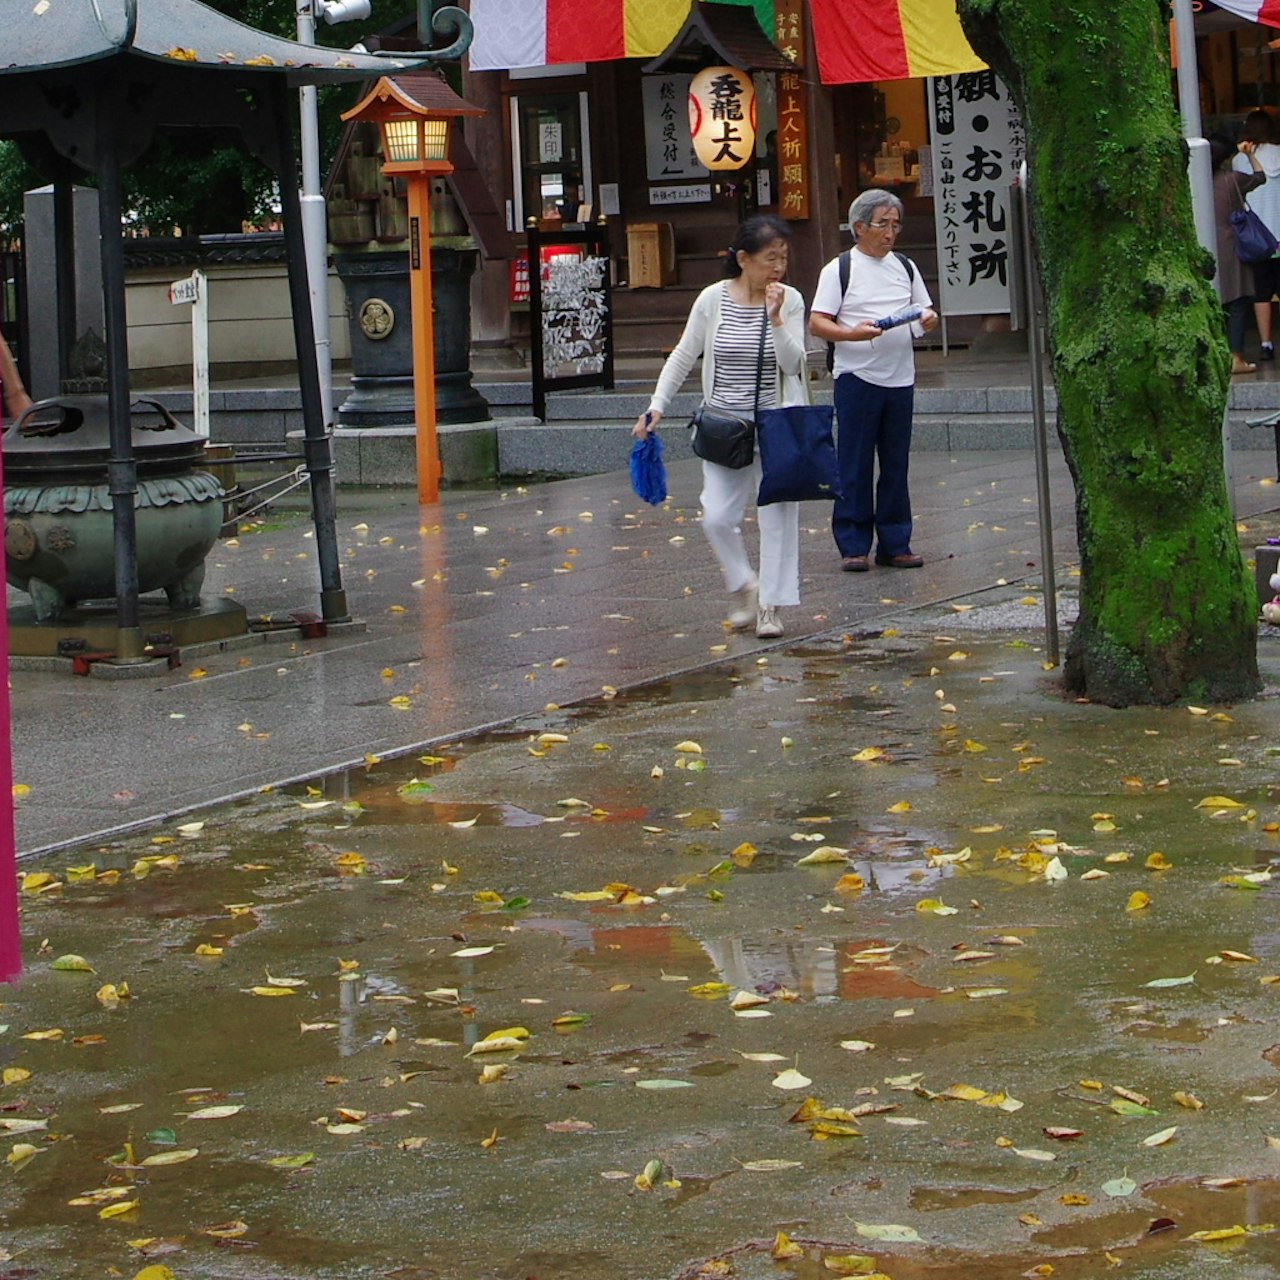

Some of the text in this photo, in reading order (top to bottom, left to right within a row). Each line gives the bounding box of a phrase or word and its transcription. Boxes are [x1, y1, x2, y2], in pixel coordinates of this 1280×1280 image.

[543, 125, 558, 155] 朱印
[659, 82, 679, 163] 総合受付
[708, 73, 744, 163] 呑龍上人
[938, 141, 961, 287] ご自由にお入り下さい
